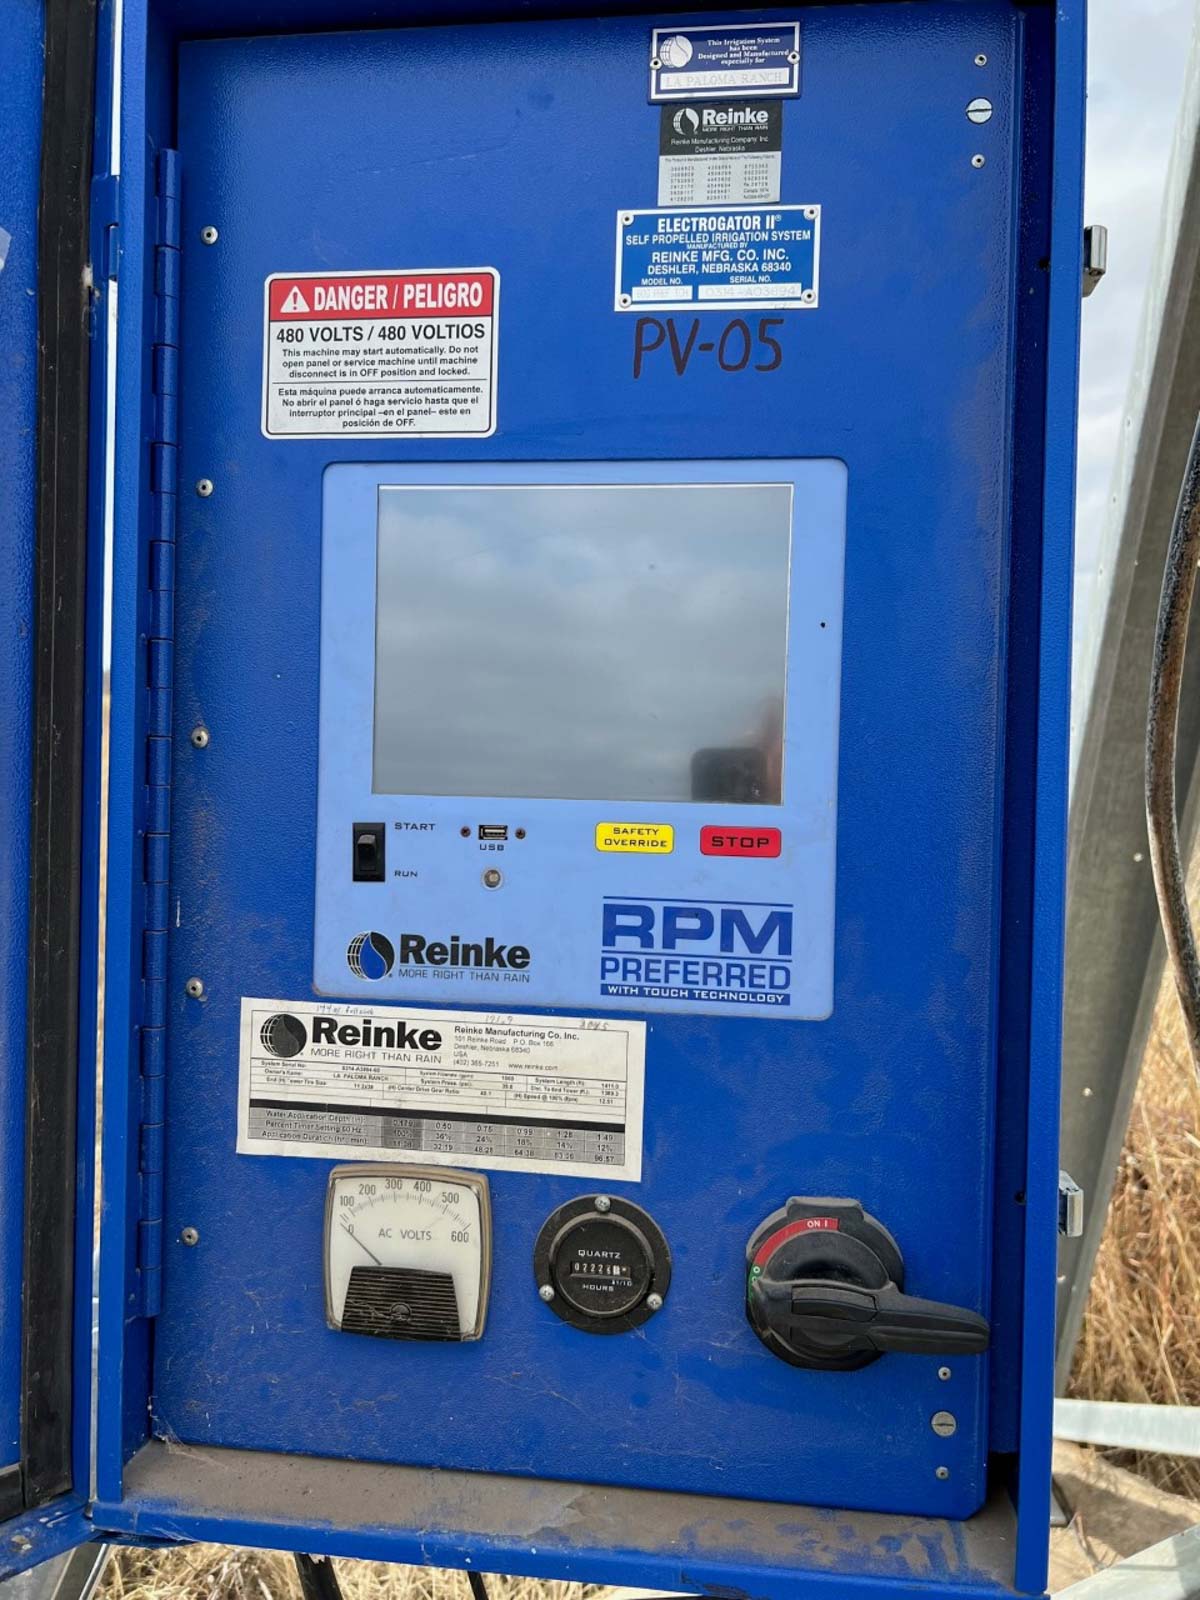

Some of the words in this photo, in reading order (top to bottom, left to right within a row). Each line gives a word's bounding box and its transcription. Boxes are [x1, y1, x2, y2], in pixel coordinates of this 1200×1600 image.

[723, 39, 756, 47] Irrigation
[756, 37, 780, 45] System
[698, 52, 728, 60] Designed
[720, 58, 753, 66] especially
[666, 76, 682, 87] LA
[686, 74, 736, 86] PALOMA
[741, 72, 782, 84] RANCH
[702, 108, 768, 126] Reinke
[657, 215, 761, 233] ELECTROGATOR
[626, 234, 649, 245] SELF
[652, 233, 709, 244] PROPELLED
[712, 231, 768, 243] IRRIGATION
[771, 230, 810, 240] SYSTEM
[652, 250, 698, 263] REINKE
[702, 250, 733, 262] MFG.
[736, 249, 759, 261] CO.
[763, 248, 788, 260] INC.
[647, 264, 699, 275] DESHLER,
[701, 262, 759, 273] NEBRASKA
[760, 262, 792, 272] 68340
[729, 275, 756, 283] SERIAL
[314, 284, 388, 310] DANGER
[392, 284, 398, 309] /
[403, 282, 482, 308] PELIGRO
[276, 328, 304, 343] 480
[309, 326, 363, 342] VOLTS
[367, 326, 374, 340] /
[377, 325, 406, 340] 480
[411, 323, 485, 340] VOLTIOS
[282, 348, 300, 356] This
[303, 348, 340, 356] machine
[342, 349, 360, 357] may
[363, 347, 383, 355] start
[385, 346, 446, 355] automatically.
[634, 317, 784, 379] PV-05
[282, 360, 304, 369] open
[306, 359, 330, 368] panel
[343, 358, 376, 366] service
[377, 357, 416, 365] machine
[417, 356, 438, 365] until
[439, 356, 478, 364] machine
[288, 370, 336, 378] disconnect
[339, 369, 346, 377] is
[359, 368, 378, 376] OFF
[380, 368, 417, 378] position
[418, 368, 436, 376] and
[438, 367, 470, 375] locked.
[278, 388, 297, 396] Esta
[339, 387, 366, 397] puede
[404, 385, 483, 394] automaticamente.
[296, 398, 317, 406] abrir
[318, 398, 327, 406] el
[329, 398, 353, 408] panel
[363, 398, 385, 407] haga
[387, 397, 423, 405] servicio
[451, 398, 468, 406] que
[470, 396, 478, 404] el
[289, 409, 336, 418] interruptor
[337, 408, 376, 419] principal
[396, 408, 404, 416] el
[342, 419, 380, 428] posición
[395, 418, 415, 426] OFF.
[394, 822, 436, 832] START
[612, 827, 659, 837] SAFETY
[604, 838, 667, 848] OVERRIDE
[711, 835, 770, 848] STOP
[394, 870, 418, 878] RUN
[601, 904, 792, 956] RPM
[400, 934, 530, 969] Reinke
[398, 968, 428, 978] MORE
[432, 970, 464, 979] RIGHT
[470, 971, 499, 981] THAN
[503, 973, 530, 983] RAIN
[600, 958, 790, 990] PREFERRED
[607, 985, 638, 994] WITH
[643, 987, 688, 997] TOUCH
[692, 990, 784, 1003] TECHNOLOGY
[312, 1016, 442, 1050] Reinke
[454, 1026, 483, 1035] Reinke
[484, 1027, 546, 1039] Manufacturing
[547, 1030, 562, 1039] Co.
[564, 1032, 579, 1040] Inc.
[310, 1048, 340, 1057] MORE
[344, 1049, 376, 1059] RIGHT
[381, 1052, 411, 1062] THAN
[415, 1054, 442, 1064] RAIN
[266, 1110, 286, 1118] Water
[266, 1120, 292, 1128] Percent
[359, 1184, 376, 1196] 200
[385, 1178, 403, 1190] 300
[413, 1180, 432, 1193] 400
[340, 1196, 355, 1207] 100
[442, 1192, 460, 1204] 500
[807, 1220, 821, 1228] ON
[378, 1227, 392, 1239] AC
[400, 1228, 432, 1240] VOLTS
[451, 1231, 469, 1244] 600
[578, 1249, 621, 1259] QUARTZ
[582, 1284, 614, 1292] HOURS
